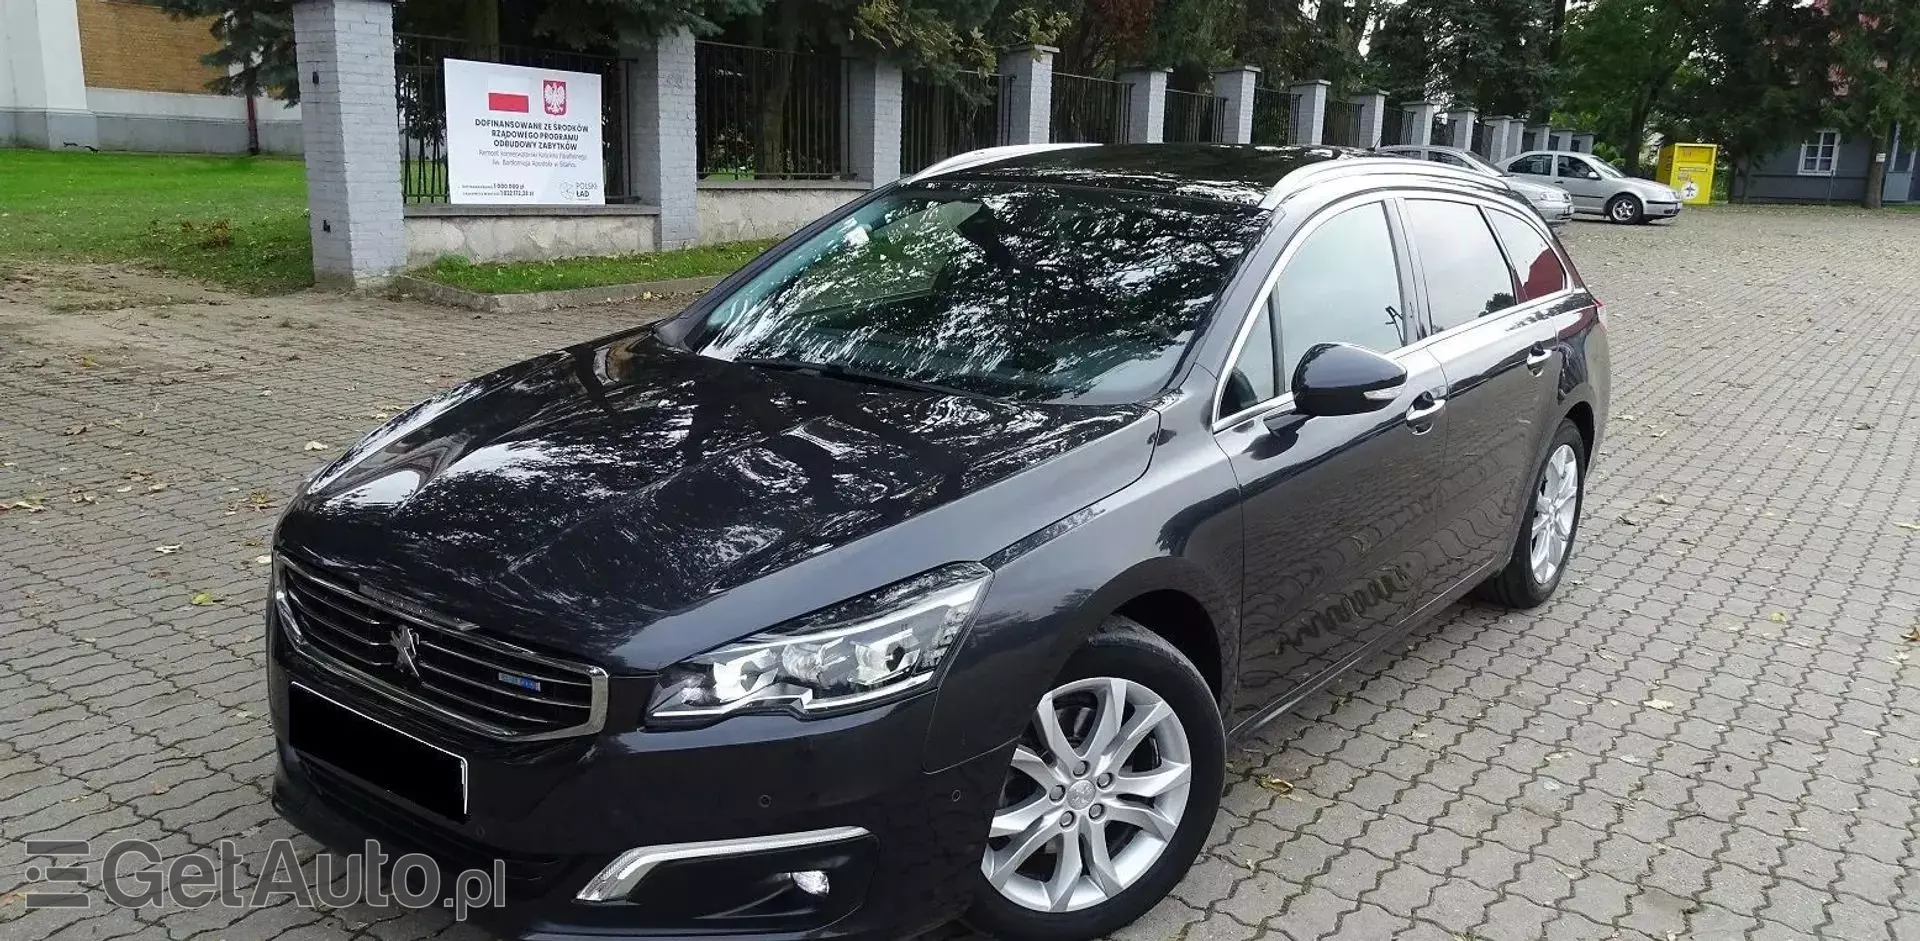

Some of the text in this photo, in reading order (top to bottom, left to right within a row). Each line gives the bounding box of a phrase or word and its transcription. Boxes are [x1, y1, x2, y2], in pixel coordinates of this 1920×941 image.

[475, 118, 542, 130] DOFINANSOWANE
[554, 121, 589, 132] ŚRODKÓW
[491, 129, 579, 141] RZĄDOWEGO PROGRAMU
[493, 139, 577, 150] ODBUDOWY ZABYTKÓW
